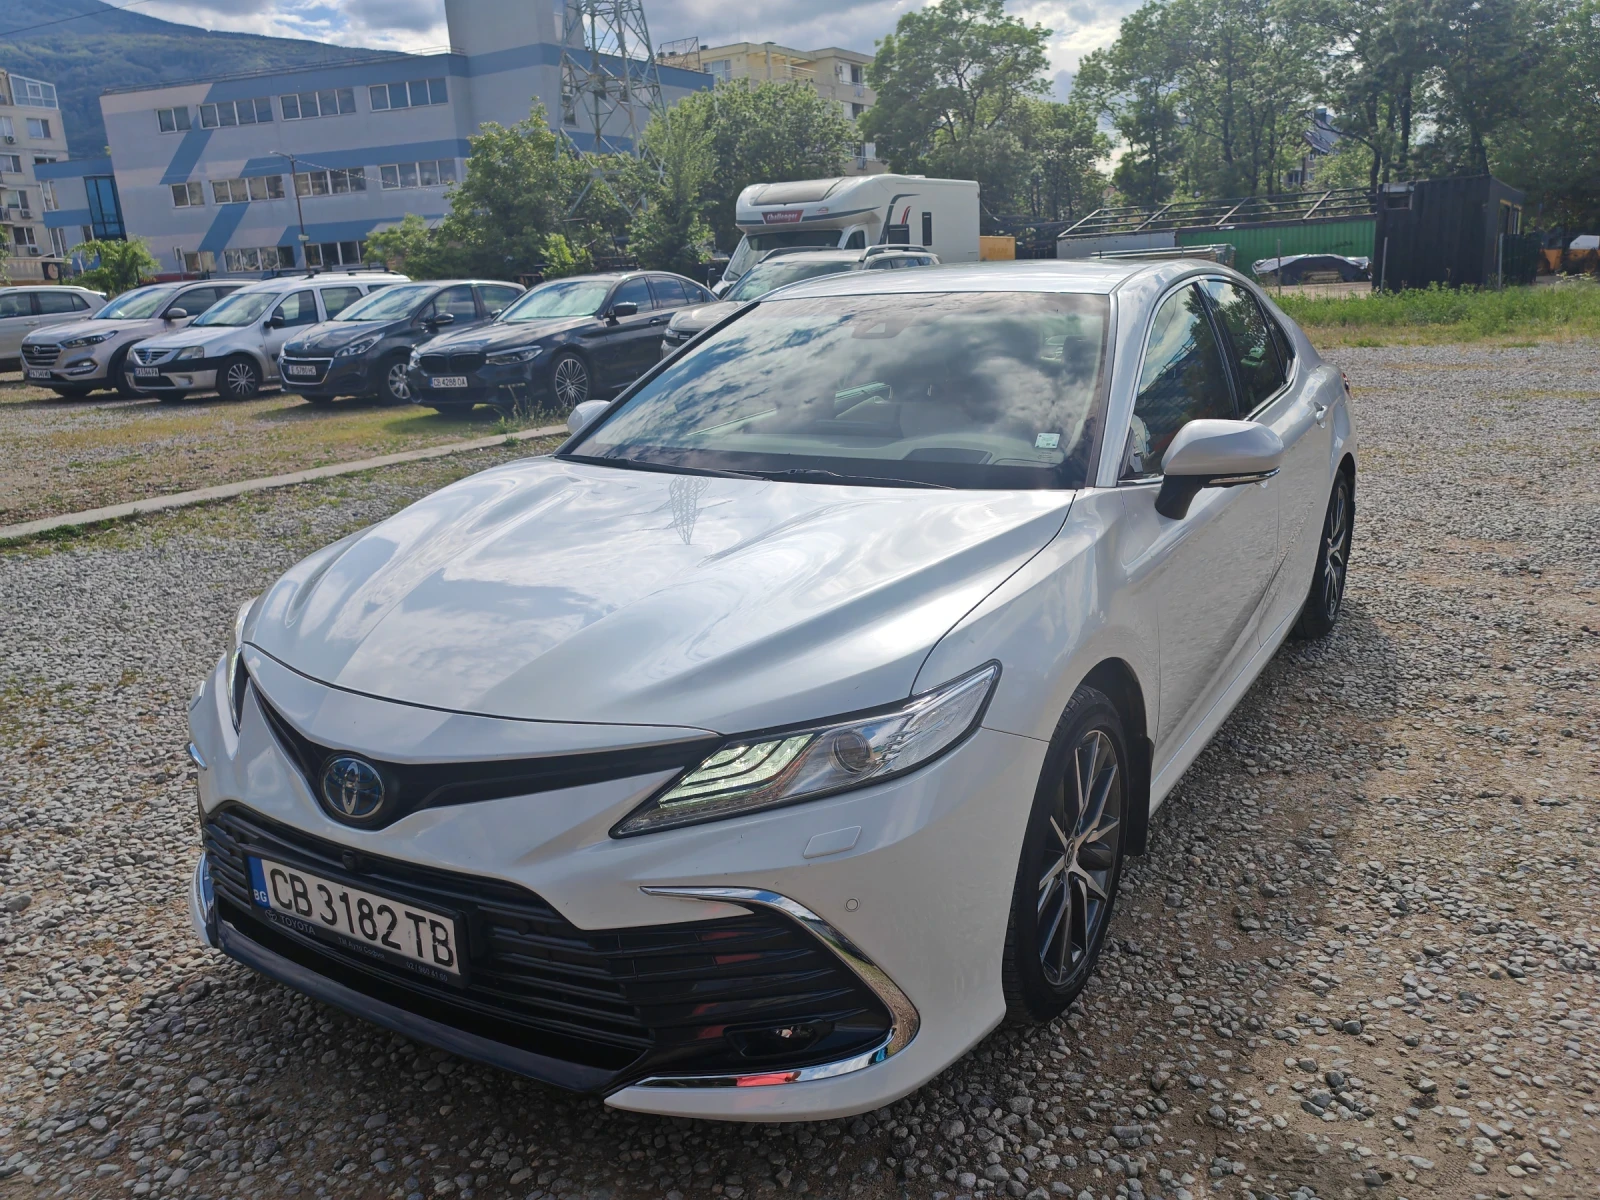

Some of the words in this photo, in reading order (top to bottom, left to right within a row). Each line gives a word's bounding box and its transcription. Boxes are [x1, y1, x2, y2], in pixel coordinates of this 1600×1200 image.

[767, 212, 798, 222] Challenger
[253, 889, 267, 903] BG
[270, 868, 312, 917] CB
[317, 884, 401, 950] 3182
[404, 910, 454, 967] TB
[280, 915, 315, 935] TOYOTA
